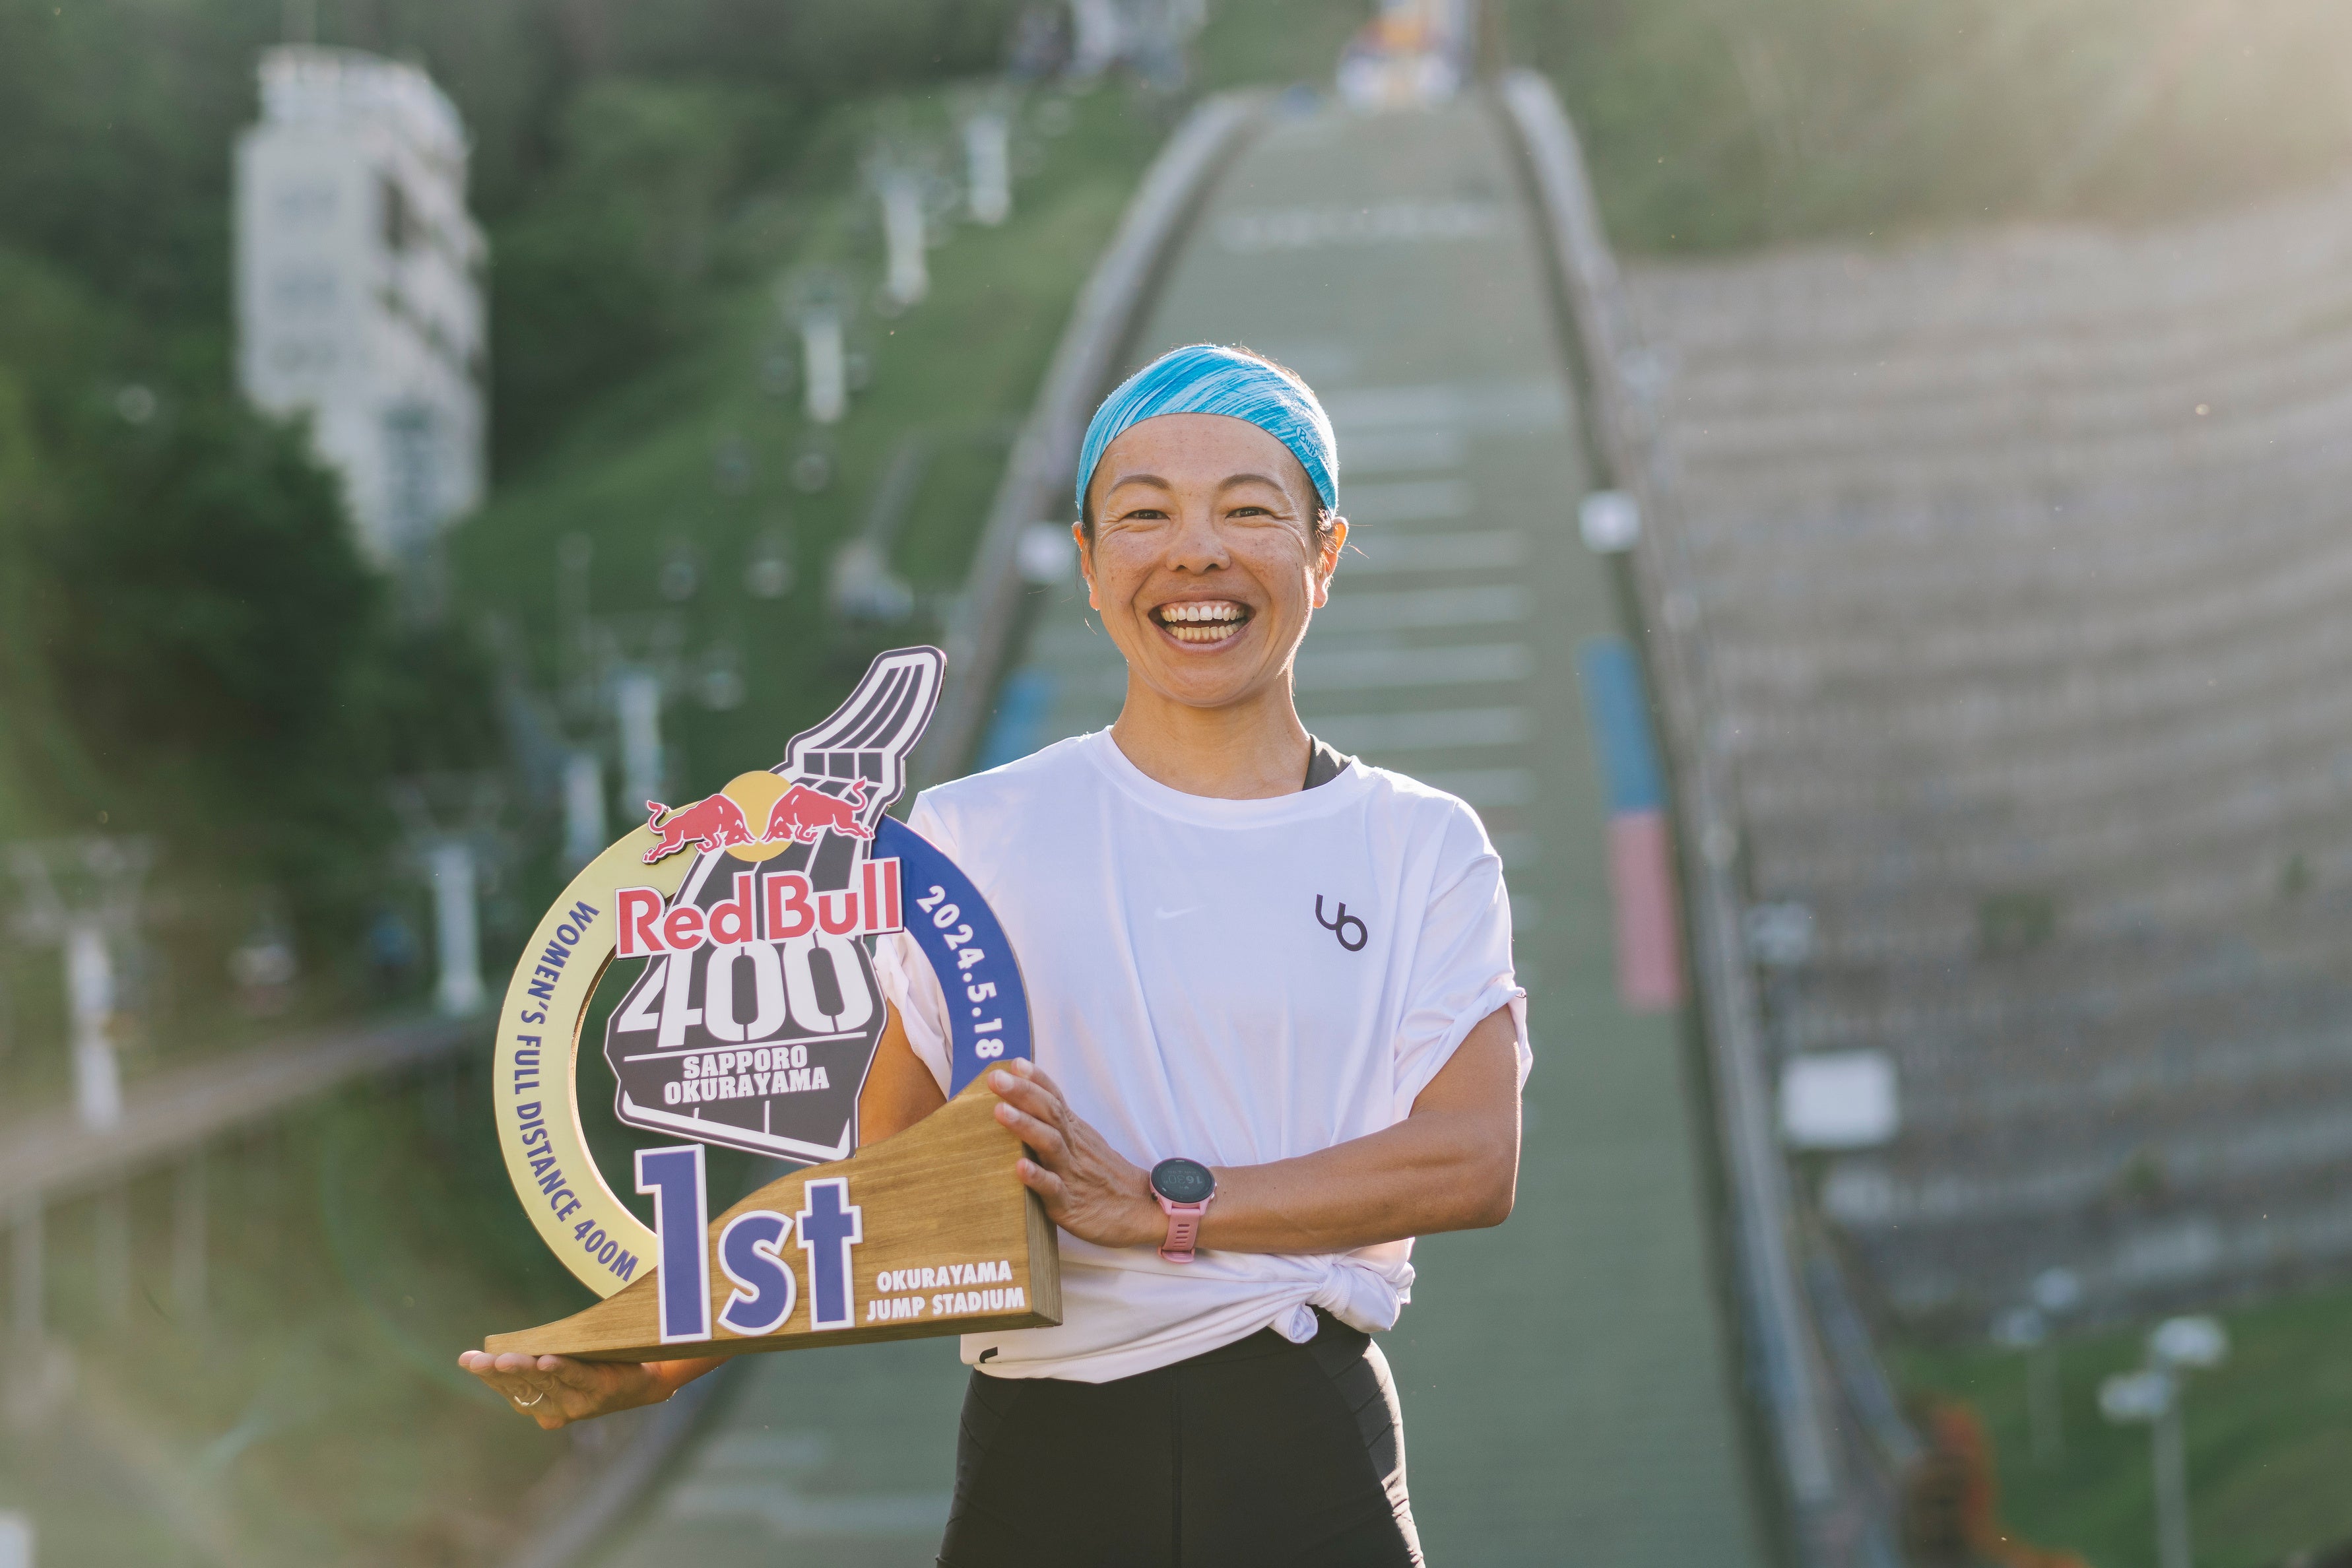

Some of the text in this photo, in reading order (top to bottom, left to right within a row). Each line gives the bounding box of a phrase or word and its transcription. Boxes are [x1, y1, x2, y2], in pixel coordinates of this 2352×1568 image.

[618, 859, 901, 956] Red Bull
[617, 937, 874, 1048] 400
[917, 885, 1004, 1059] 2024.5.18
[514, 900, 639, 1283] WOMEN'S FULL DISTANCE 400M
[664, 1066, 830, 1105] OKURAYAMA
[682, 1045, 808, 1079] SAPPORO
[636, 1144, 863, 1343] 1st
[876, 1260, 1013, 1292] OKURAYAMA
[866, 1287, 1026, 1321] JUMP STADIUM
